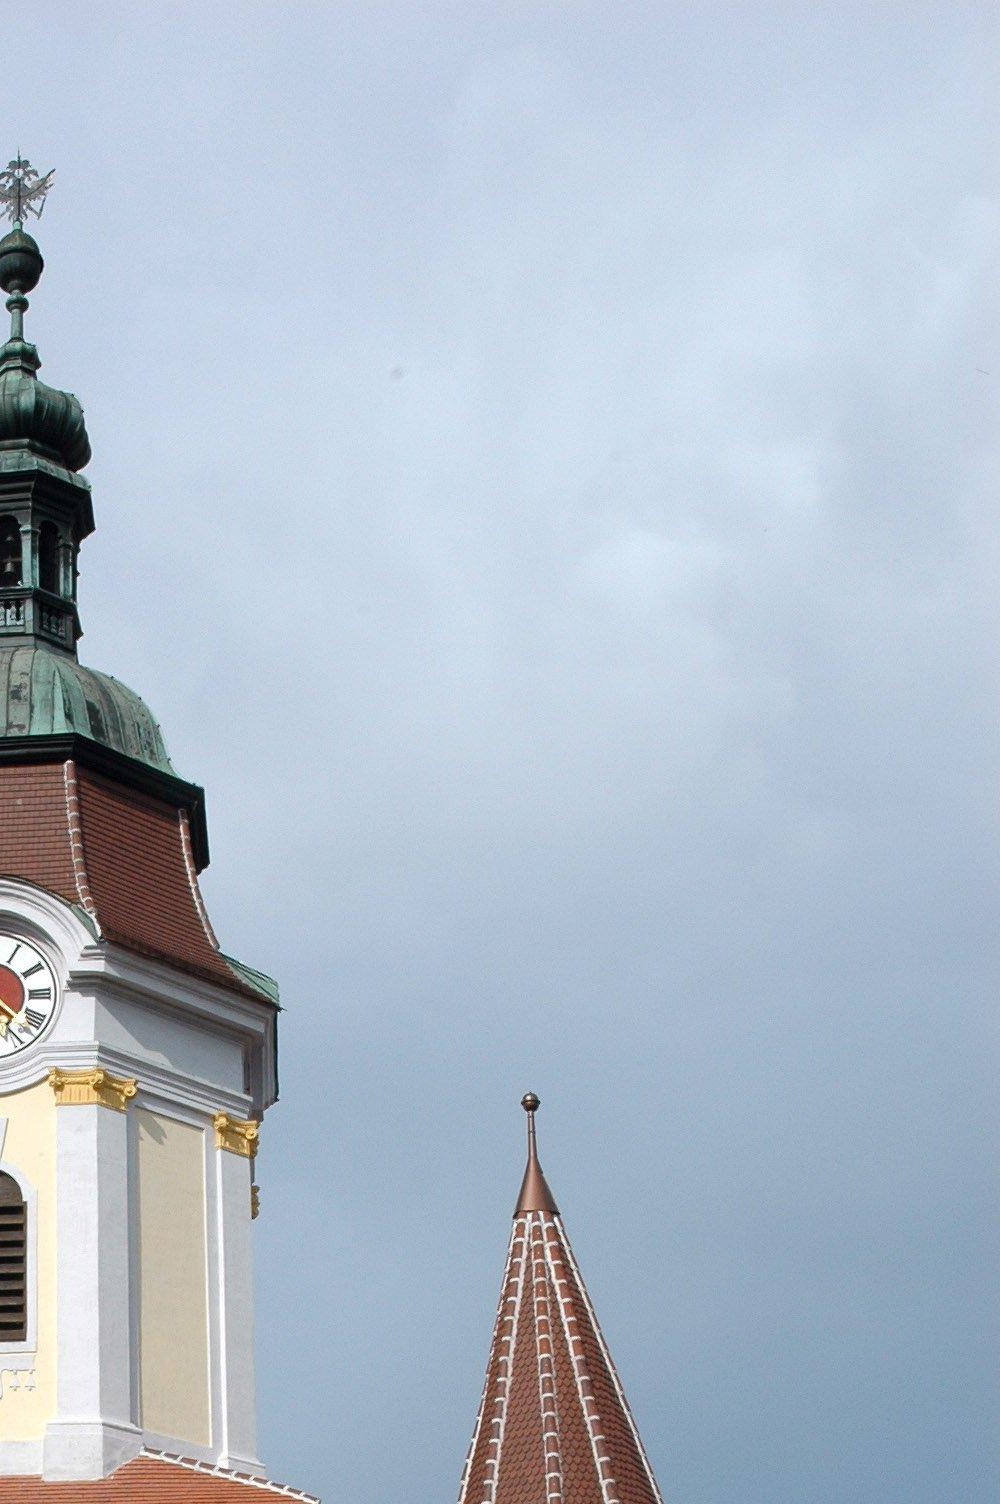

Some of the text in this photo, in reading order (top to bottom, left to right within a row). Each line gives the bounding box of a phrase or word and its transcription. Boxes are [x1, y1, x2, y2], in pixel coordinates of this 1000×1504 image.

[6, 944, 22, 964] I
[21, 961, 44, 979] II
[28, 987, 52, 1001] III
